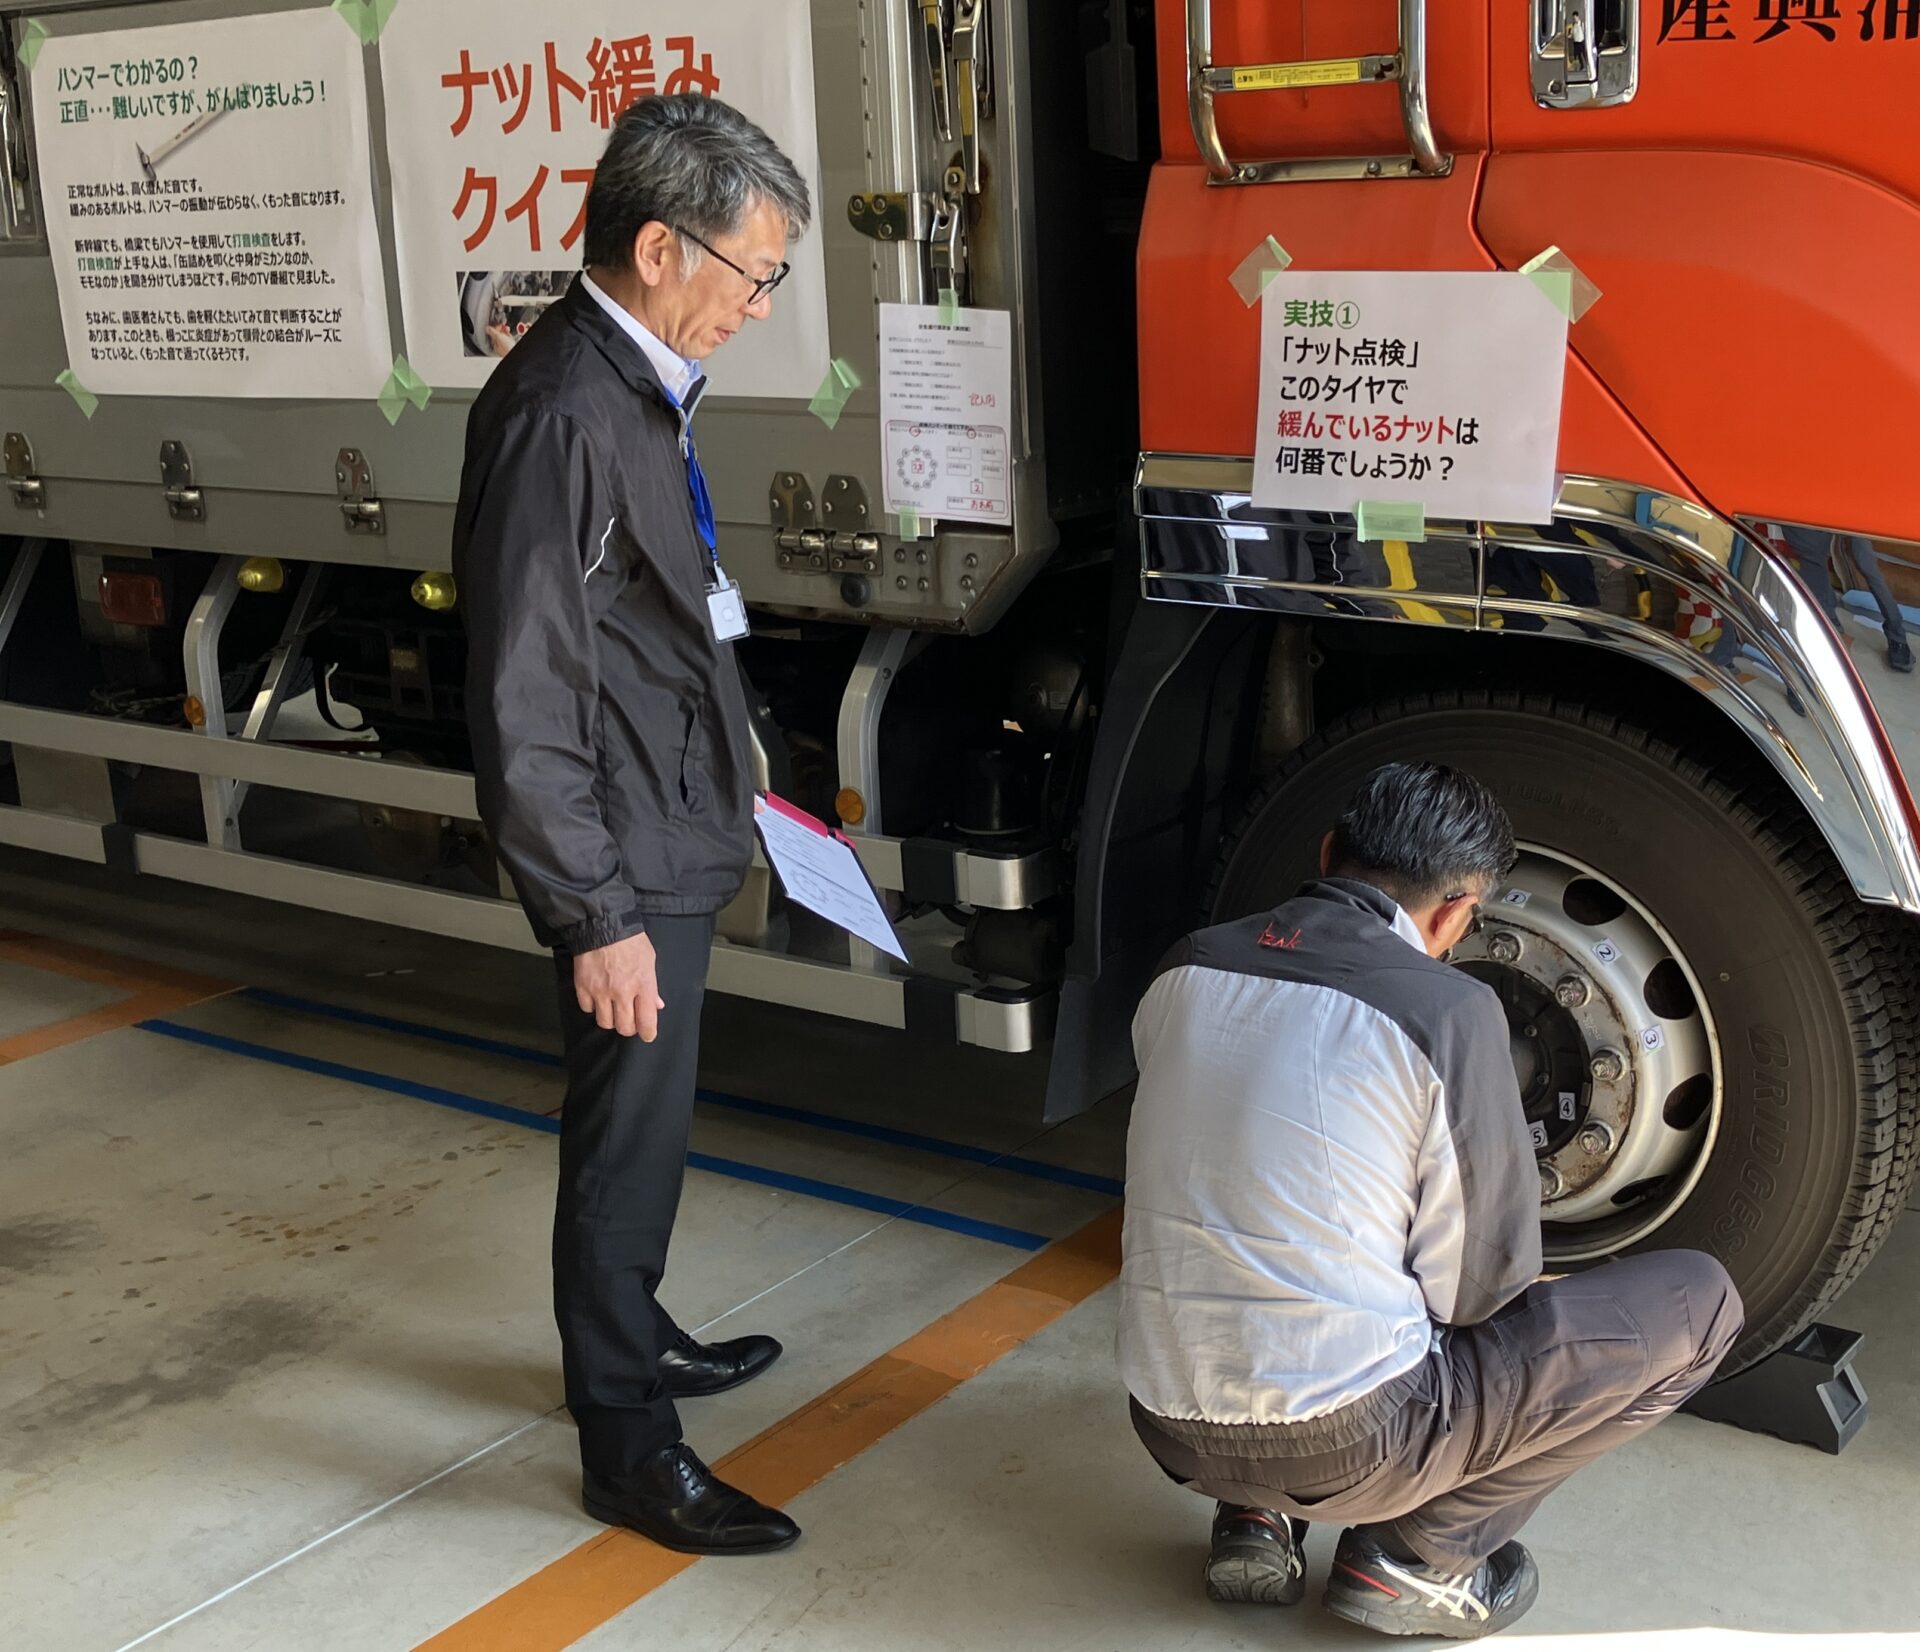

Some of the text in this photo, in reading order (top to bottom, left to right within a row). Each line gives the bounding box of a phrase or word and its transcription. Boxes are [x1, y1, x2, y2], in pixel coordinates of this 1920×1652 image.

[1282, 335, 1420, 369] 「ナット点検」
[1280, 375, 1409, 405] このタイヤで
[1276, 410, 1480, 445] 緩んでいるナットは
[1275, 445, 1455, 481] 何番でしょうか？
